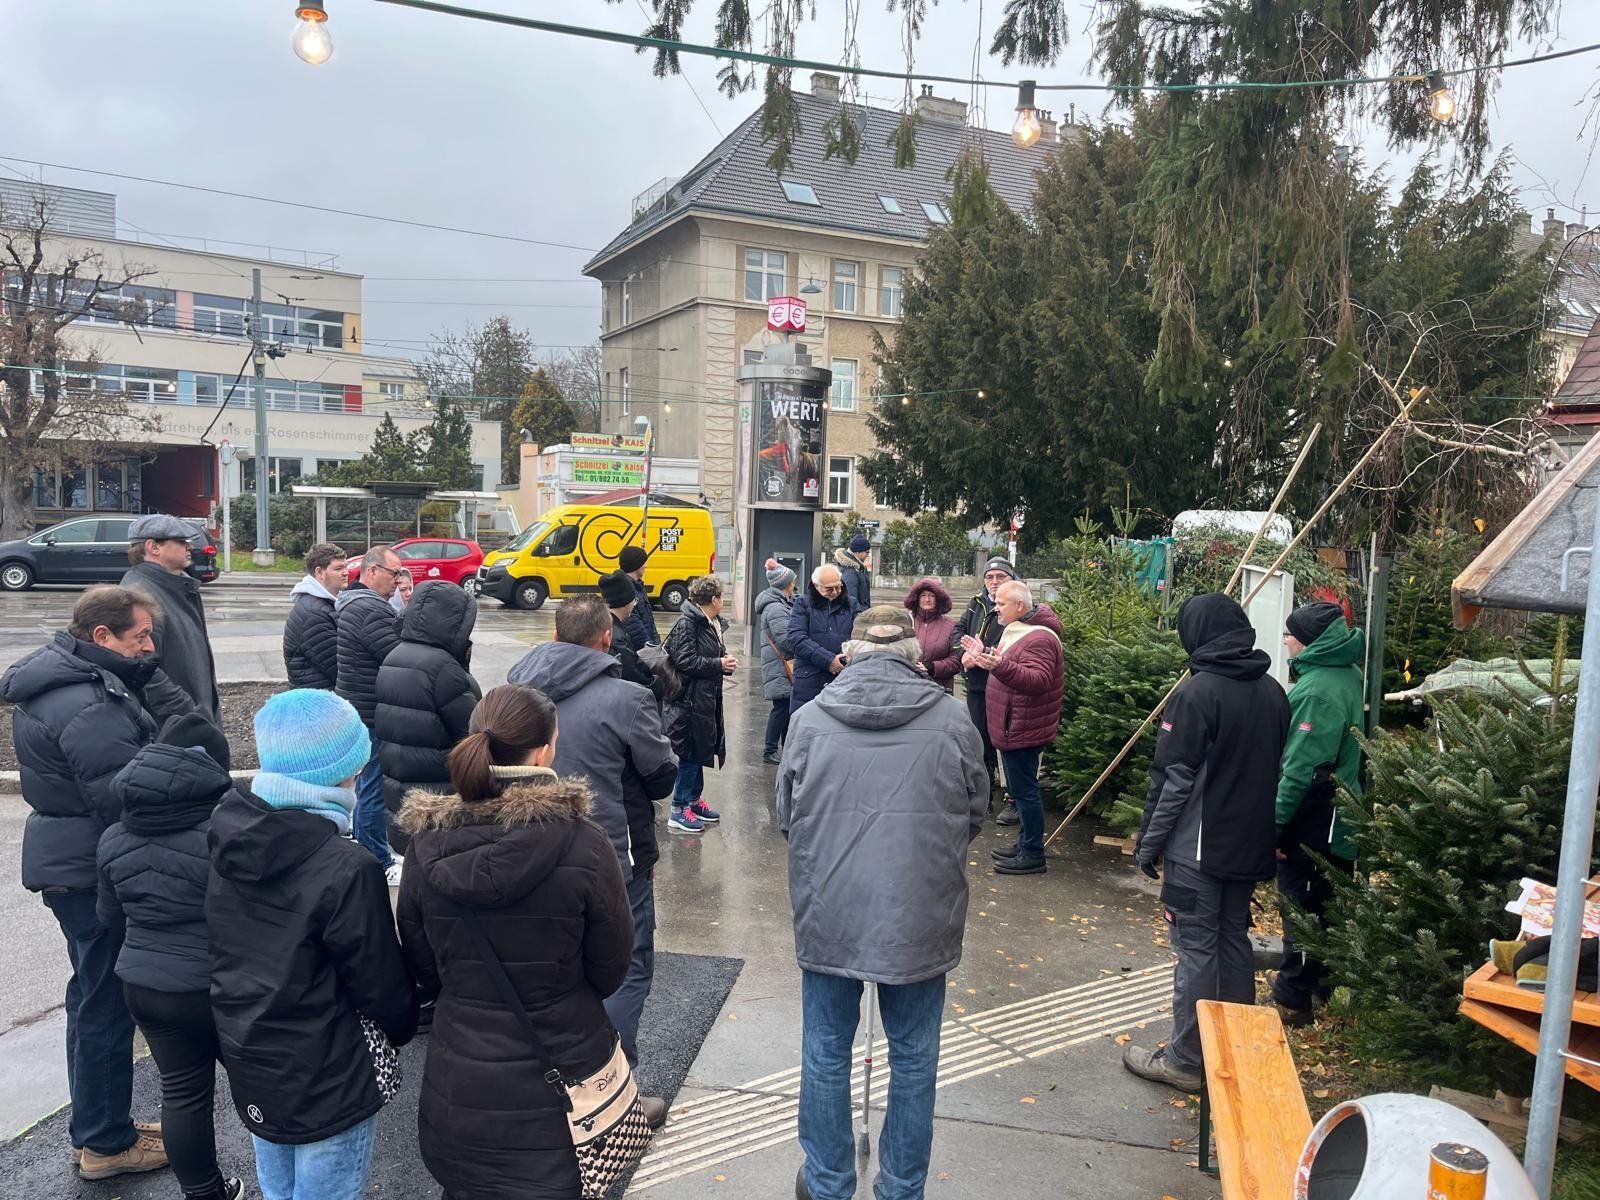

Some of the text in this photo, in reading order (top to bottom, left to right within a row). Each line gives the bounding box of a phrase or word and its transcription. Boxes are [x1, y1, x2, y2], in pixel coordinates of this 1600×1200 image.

[771, 401, 820, 421] WERT.
[221, 422, 241, 436] bis
[268, 426, 369, 442] Rosenschimmer
[572, 436, 645, 447] Schnitzel KAIS
[575, 460, 645, 472] Schnitzel Kaise
[661, 528, 682, 536] POST
[661, 535, 677, 543] FÜR
